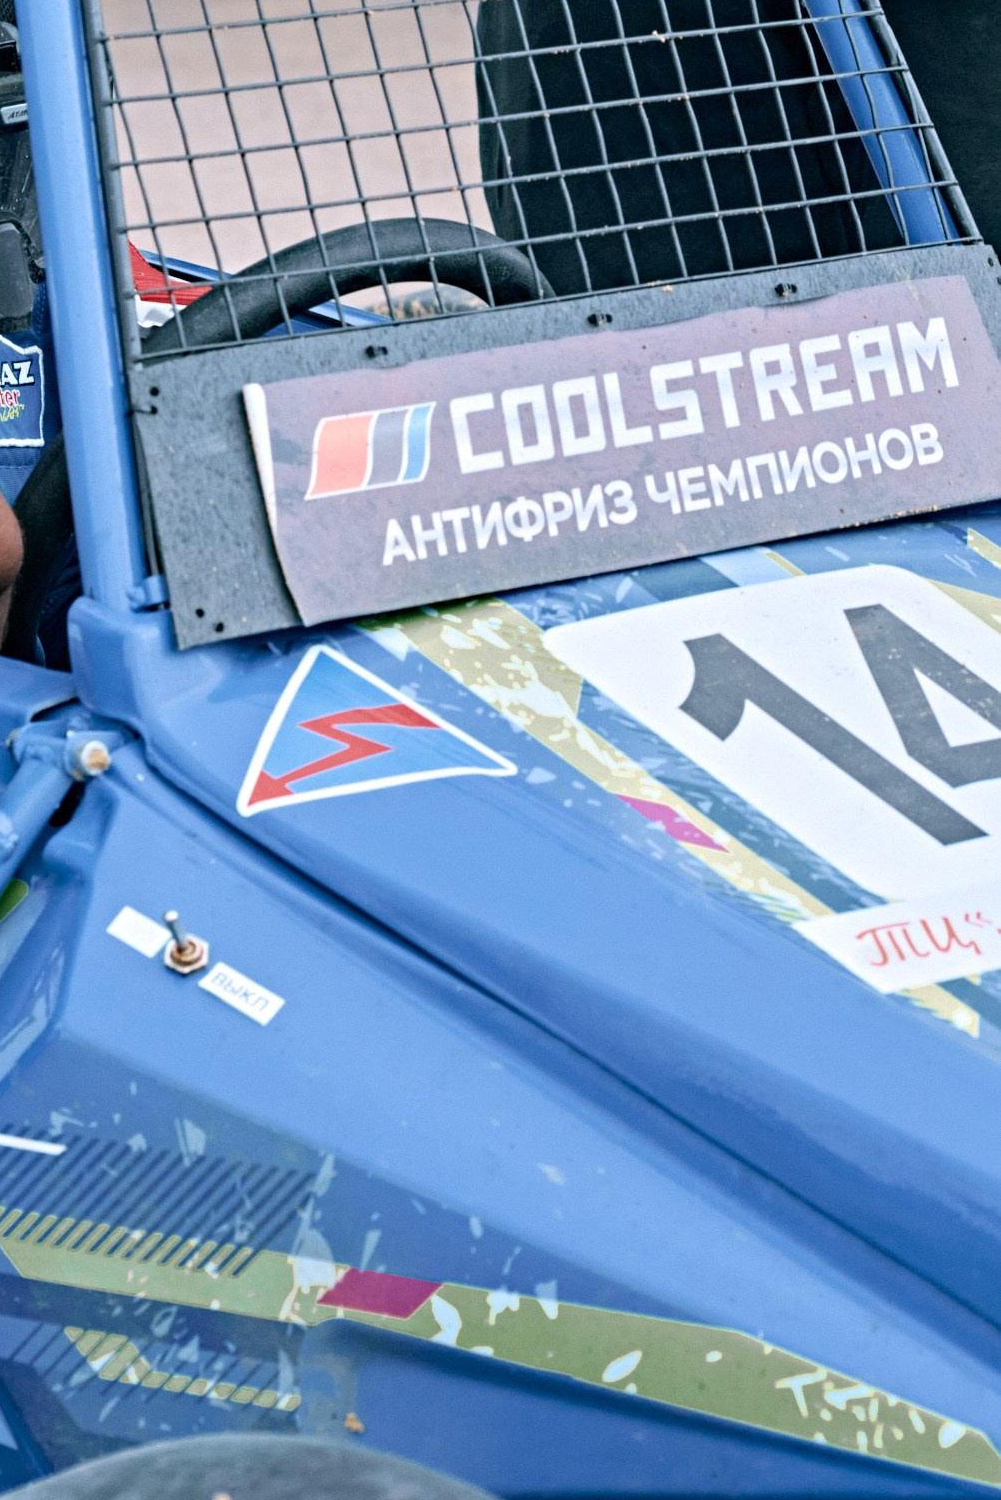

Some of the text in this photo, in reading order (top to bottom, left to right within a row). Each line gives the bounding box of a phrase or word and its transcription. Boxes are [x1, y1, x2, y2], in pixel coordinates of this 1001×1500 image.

[449, 316, 960, 475] COOLSTREAM
[381, 422, 945, 567] АНТИФРИЗ ЧЕМПИОНОВ
[678, 603, 1001, 846] 14
